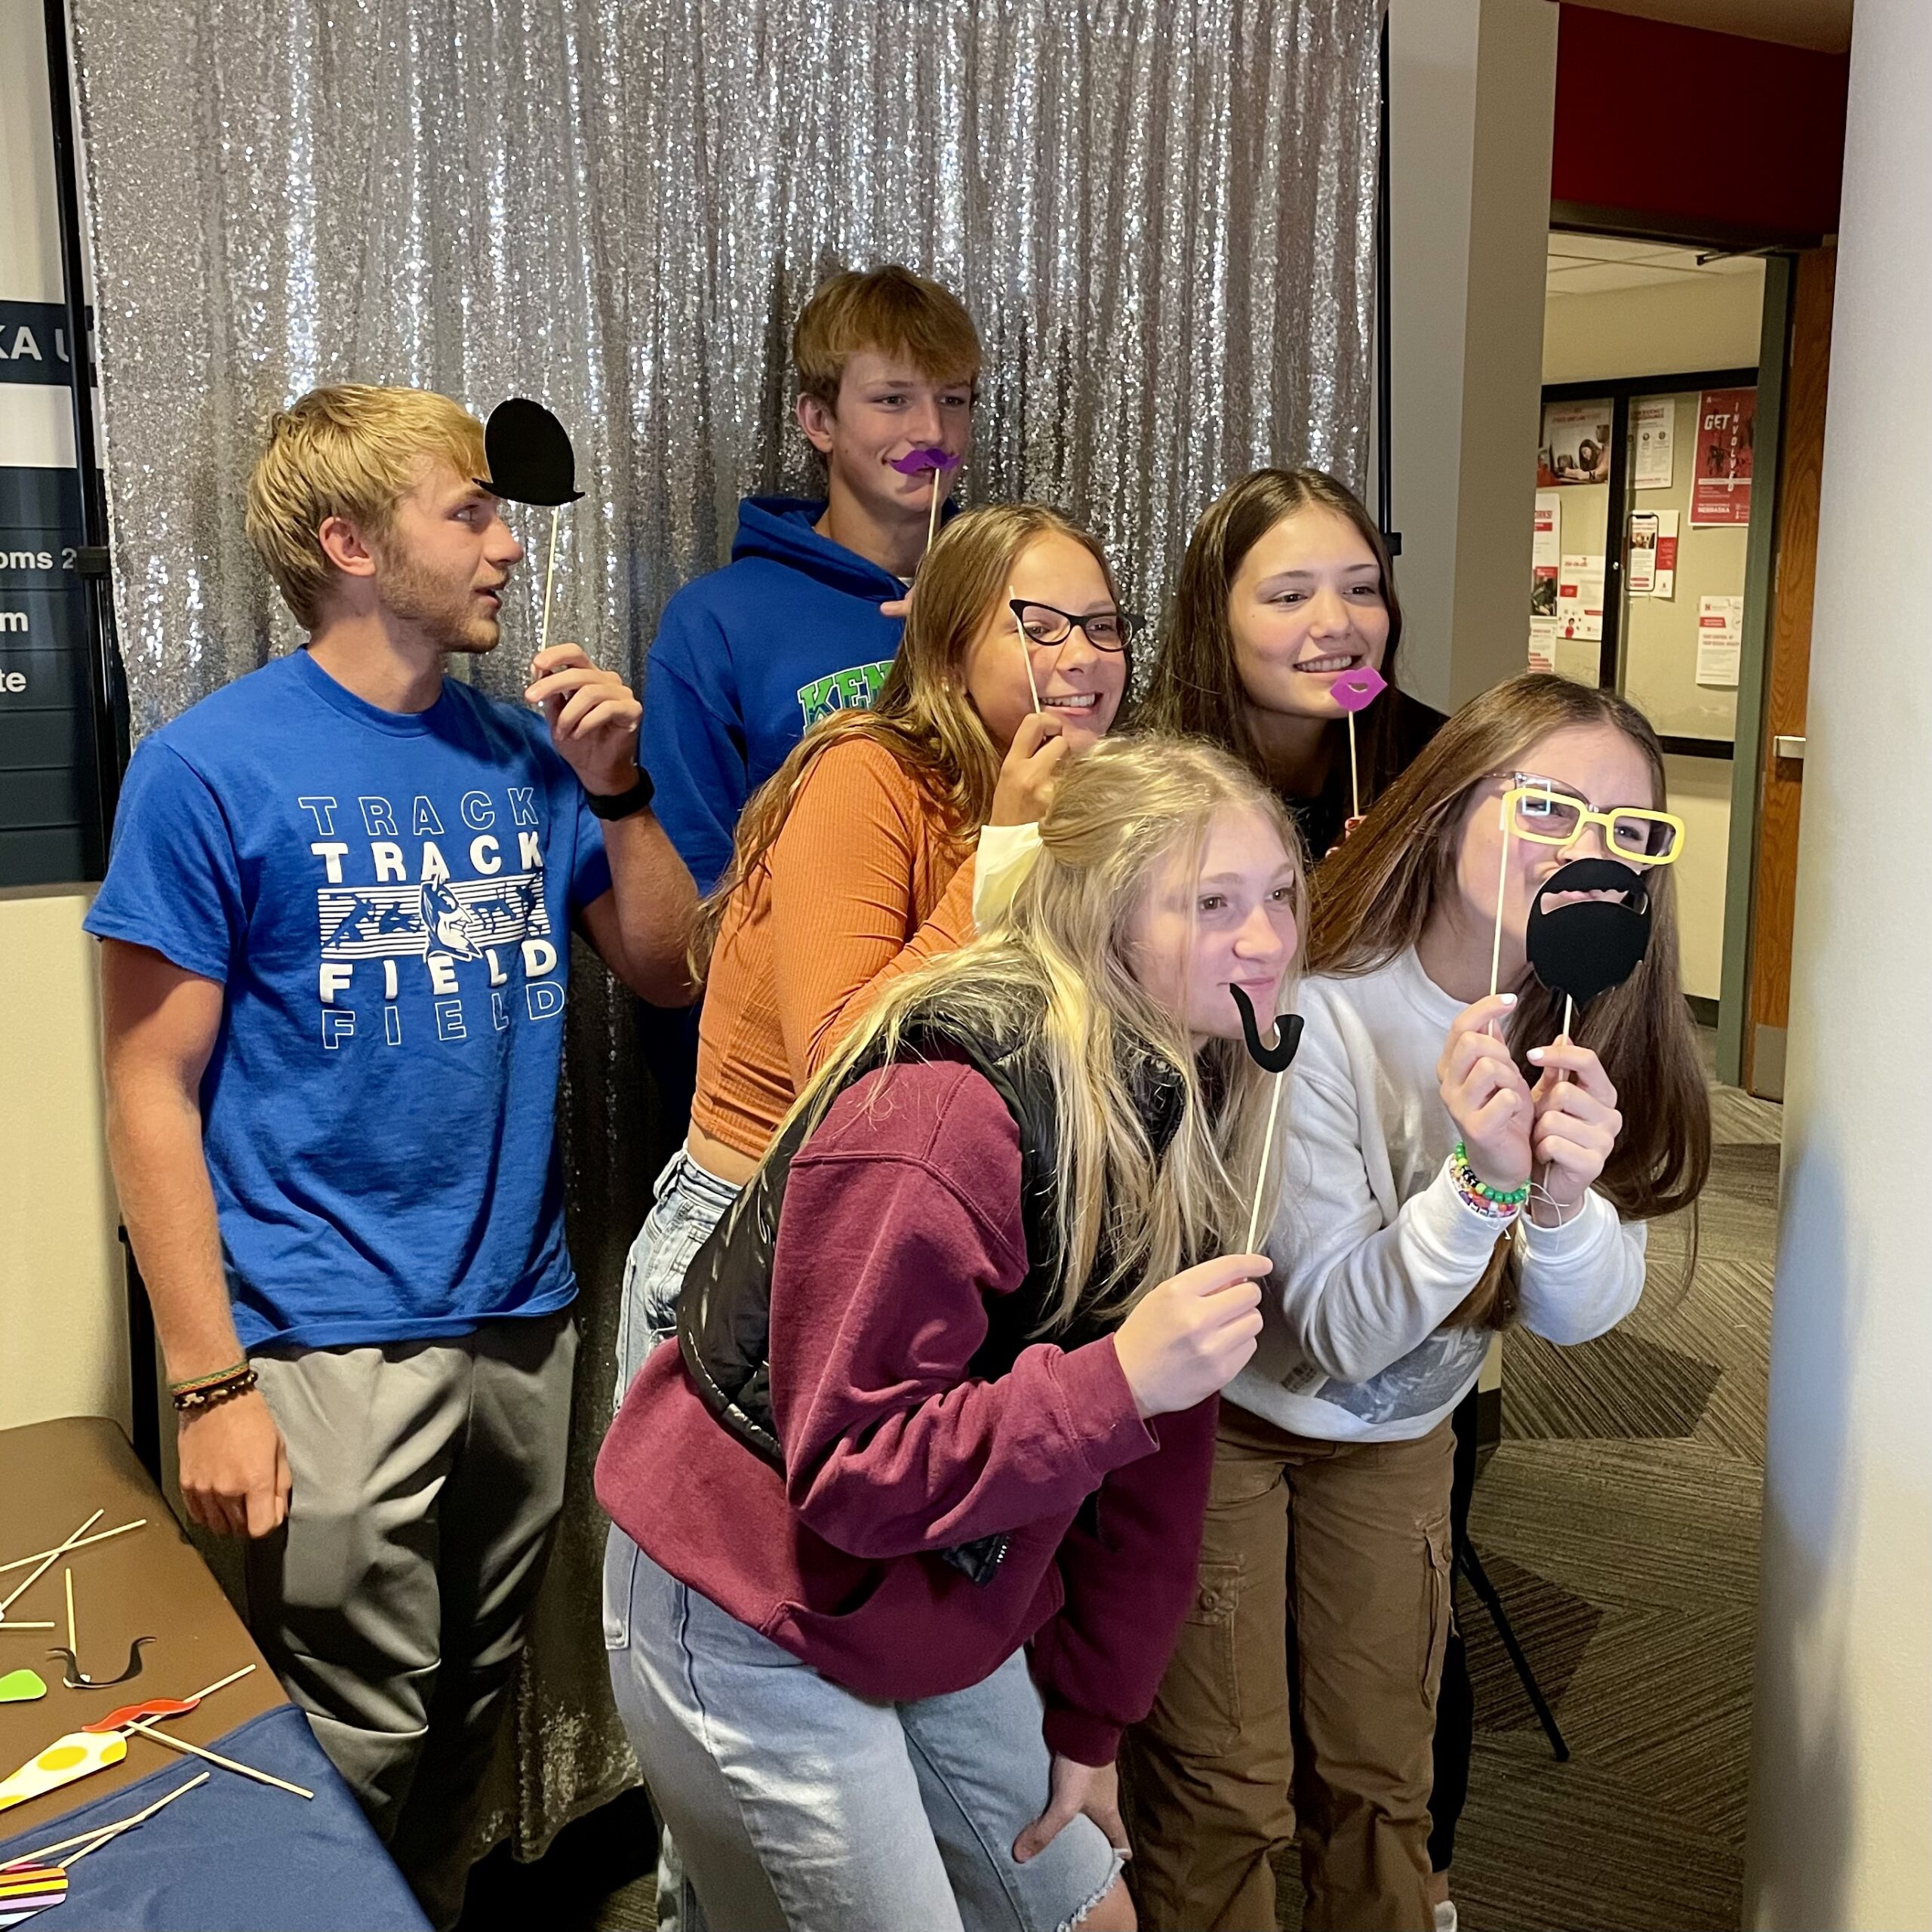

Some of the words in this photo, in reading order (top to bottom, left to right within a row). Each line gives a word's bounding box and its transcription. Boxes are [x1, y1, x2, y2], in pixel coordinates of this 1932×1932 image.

[0, 325, 42, 361] A
[1703, 414, 1730, 431] GET
[298, 786, 540, 837] TRACK
[311, 831, 543, 884] TRACK
[319, 939, 558, 1004] FIELD
[321, 980, 565, 1050] FIELD
